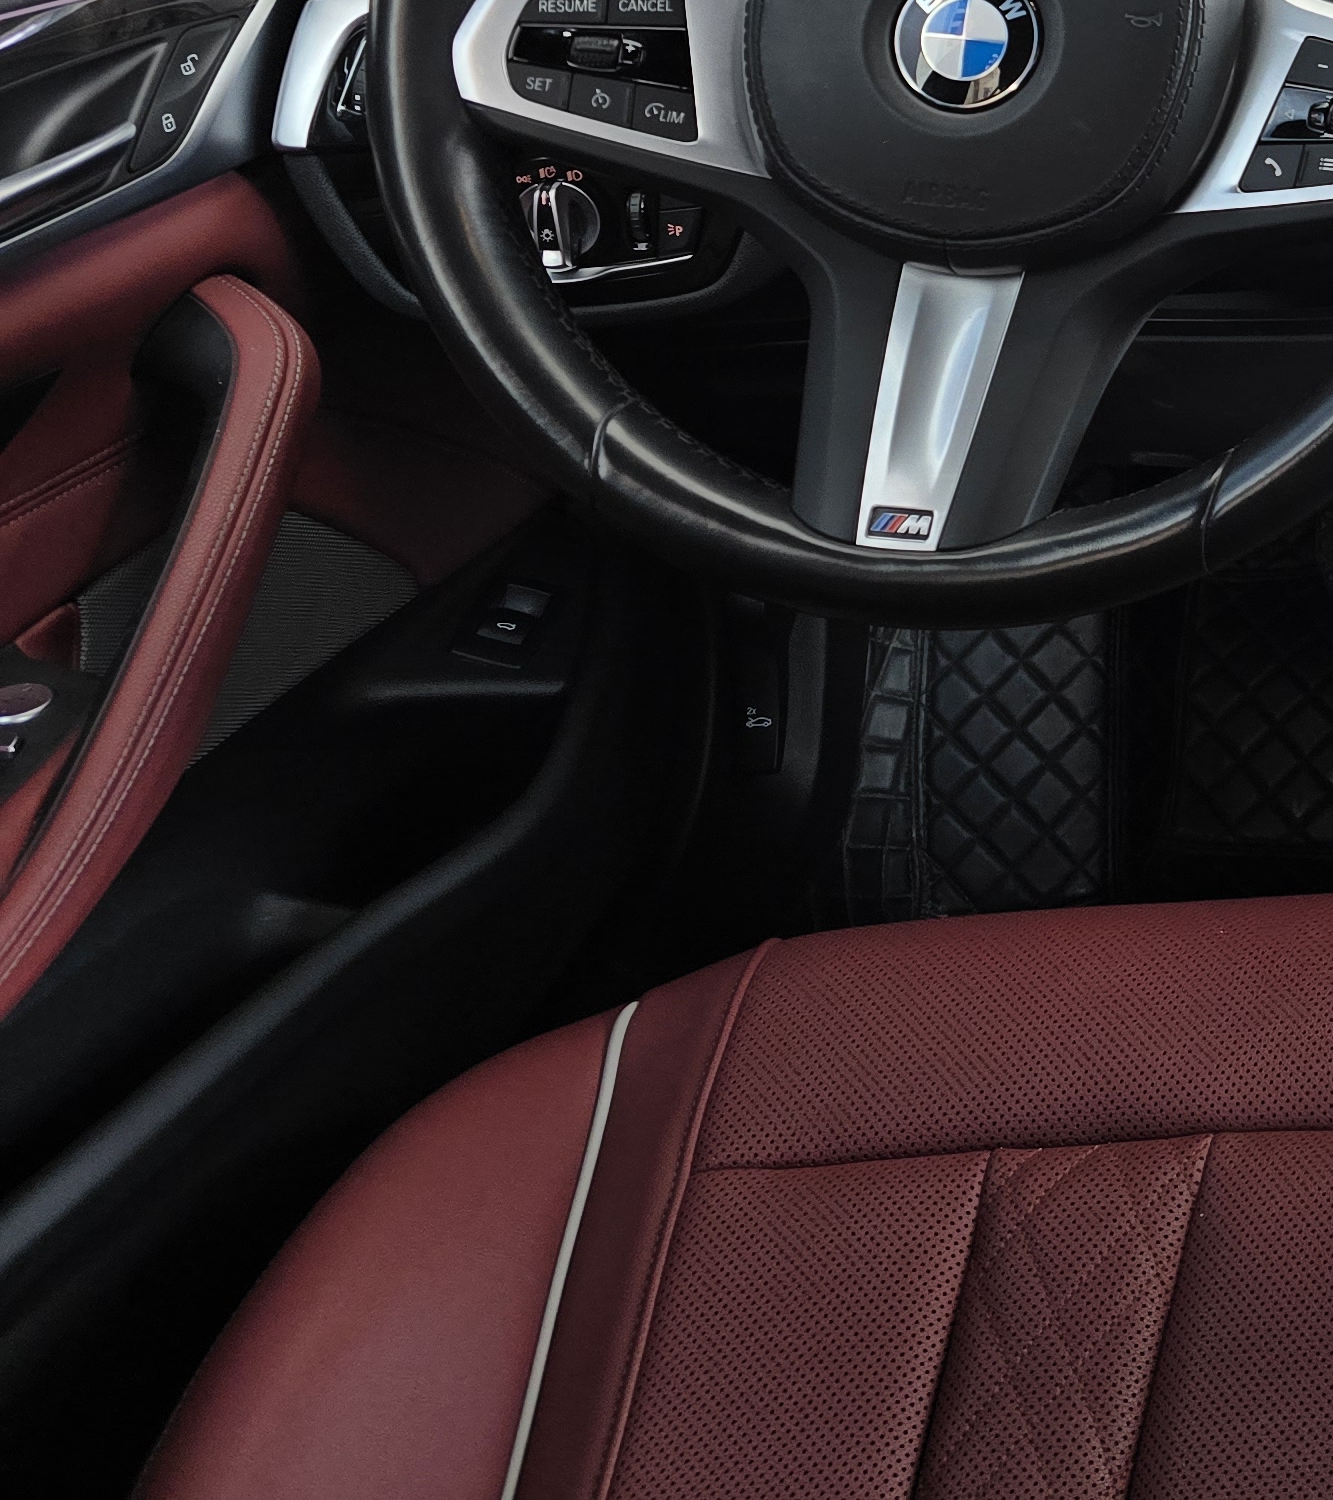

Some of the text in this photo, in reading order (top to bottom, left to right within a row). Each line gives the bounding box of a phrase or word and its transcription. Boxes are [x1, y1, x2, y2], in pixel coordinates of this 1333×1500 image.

[538, 0, 597, 13] RESUME
[618, 0, 673, 13] CANCEL
[525, 77, 553, 92] SET
[659, 111, 685, 124] LIM
